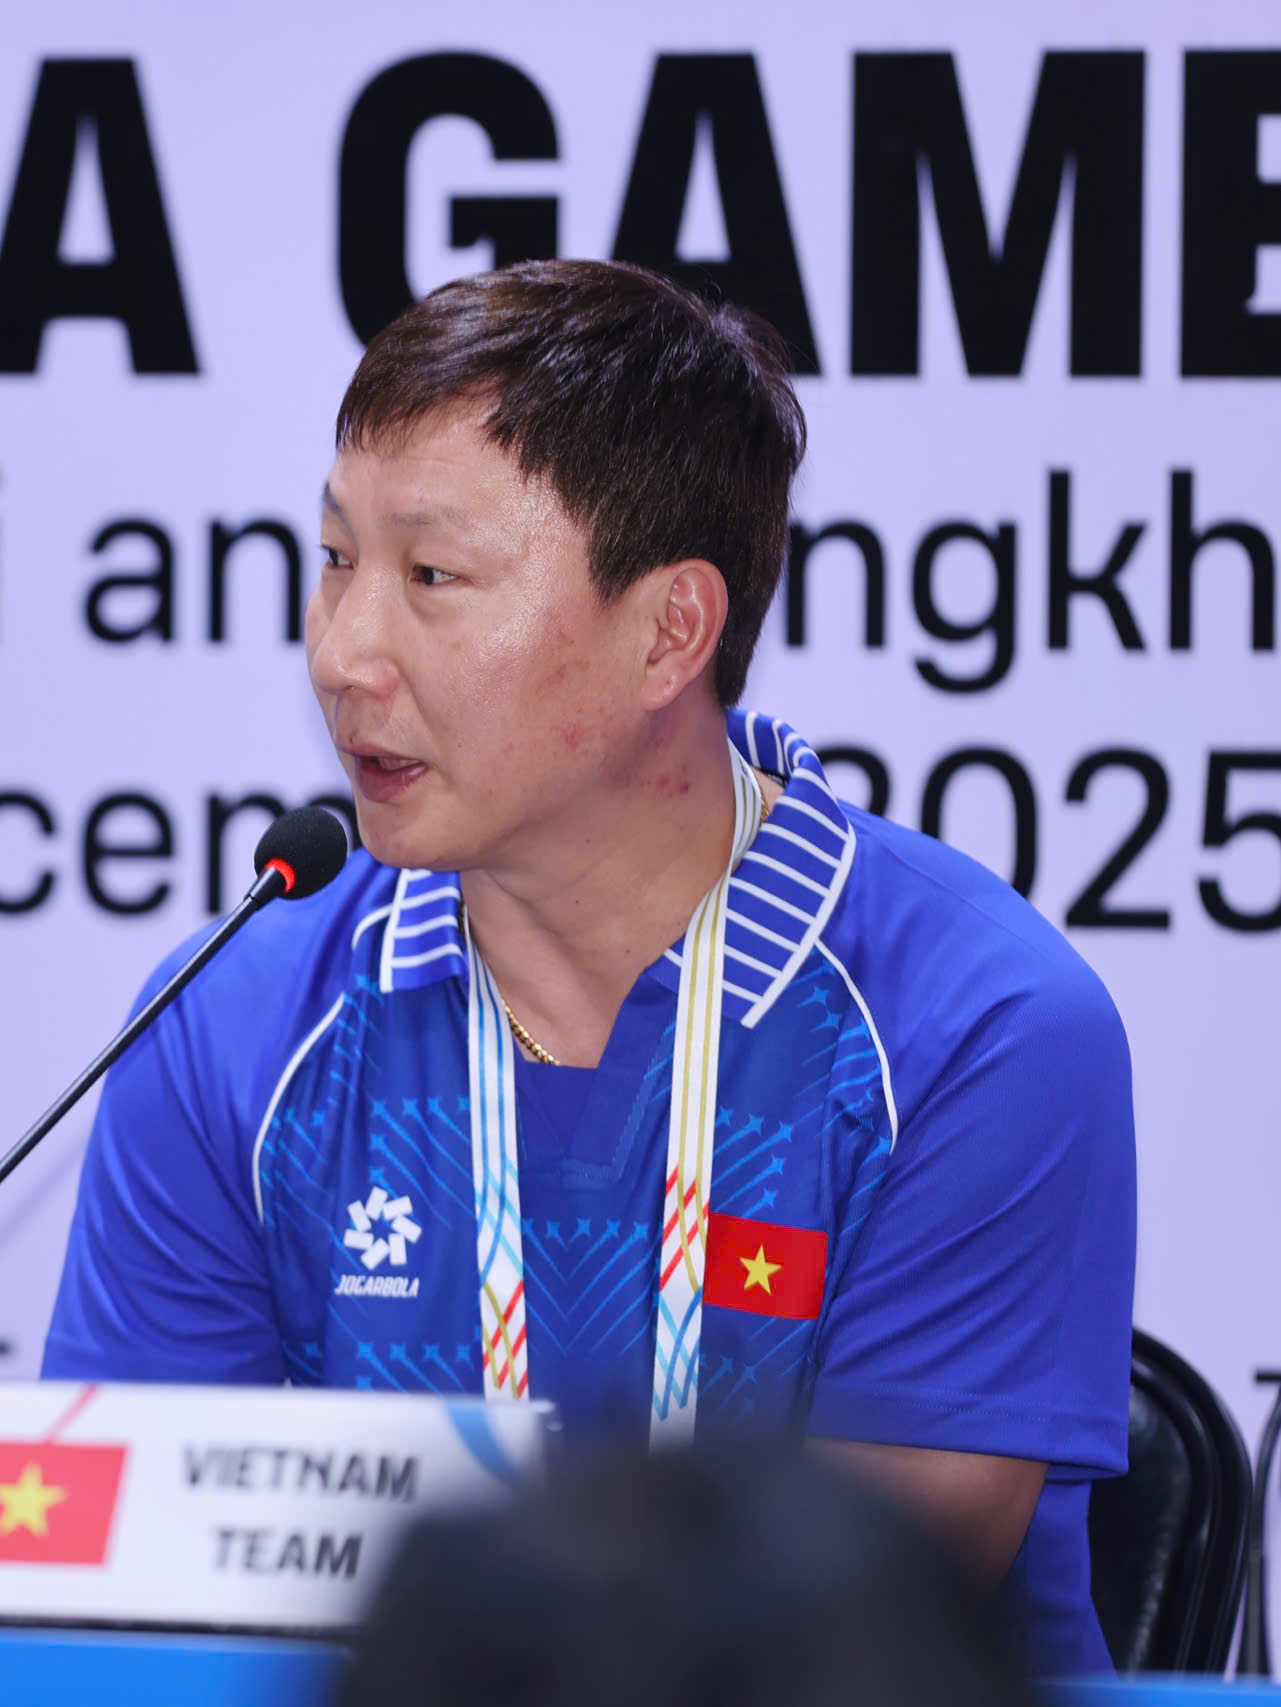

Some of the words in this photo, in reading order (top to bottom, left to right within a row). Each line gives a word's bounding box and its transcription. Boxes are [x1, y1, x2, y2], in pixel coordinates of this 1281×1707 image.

[336, 50, 1281, 378] GAME
[334, 1274, 420, 1298] JOGARBOLA
[182, 1442, 421, 1502] VIETNAM
[213, 1526, 363, 1578] TEAM
